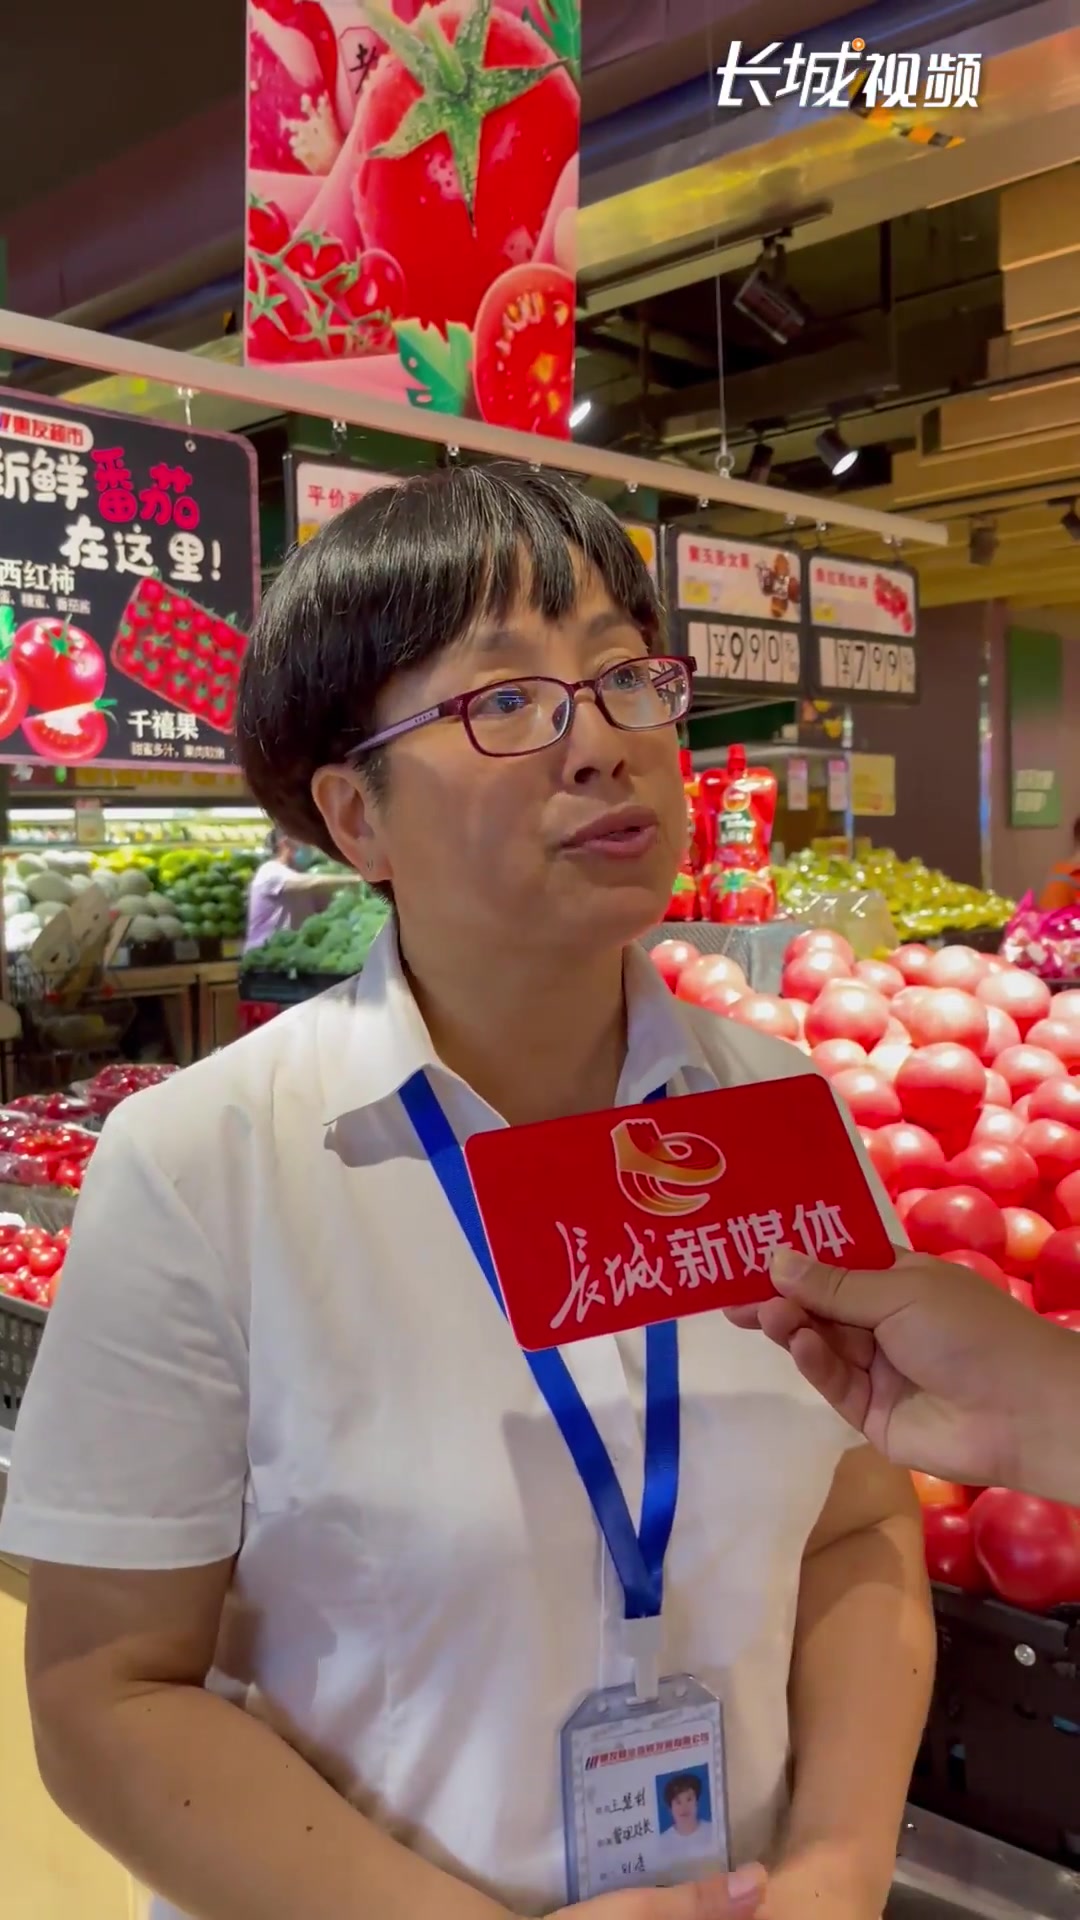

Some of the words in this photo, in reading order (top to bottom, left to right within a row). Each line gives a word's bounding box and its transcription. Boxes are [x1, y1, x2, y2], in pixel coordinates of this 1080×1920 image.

[59, 514, 222, 582] 在这里！
[0, 559, 75, 595] 西红柿
[127, 709, 199, 740] 千禧果
